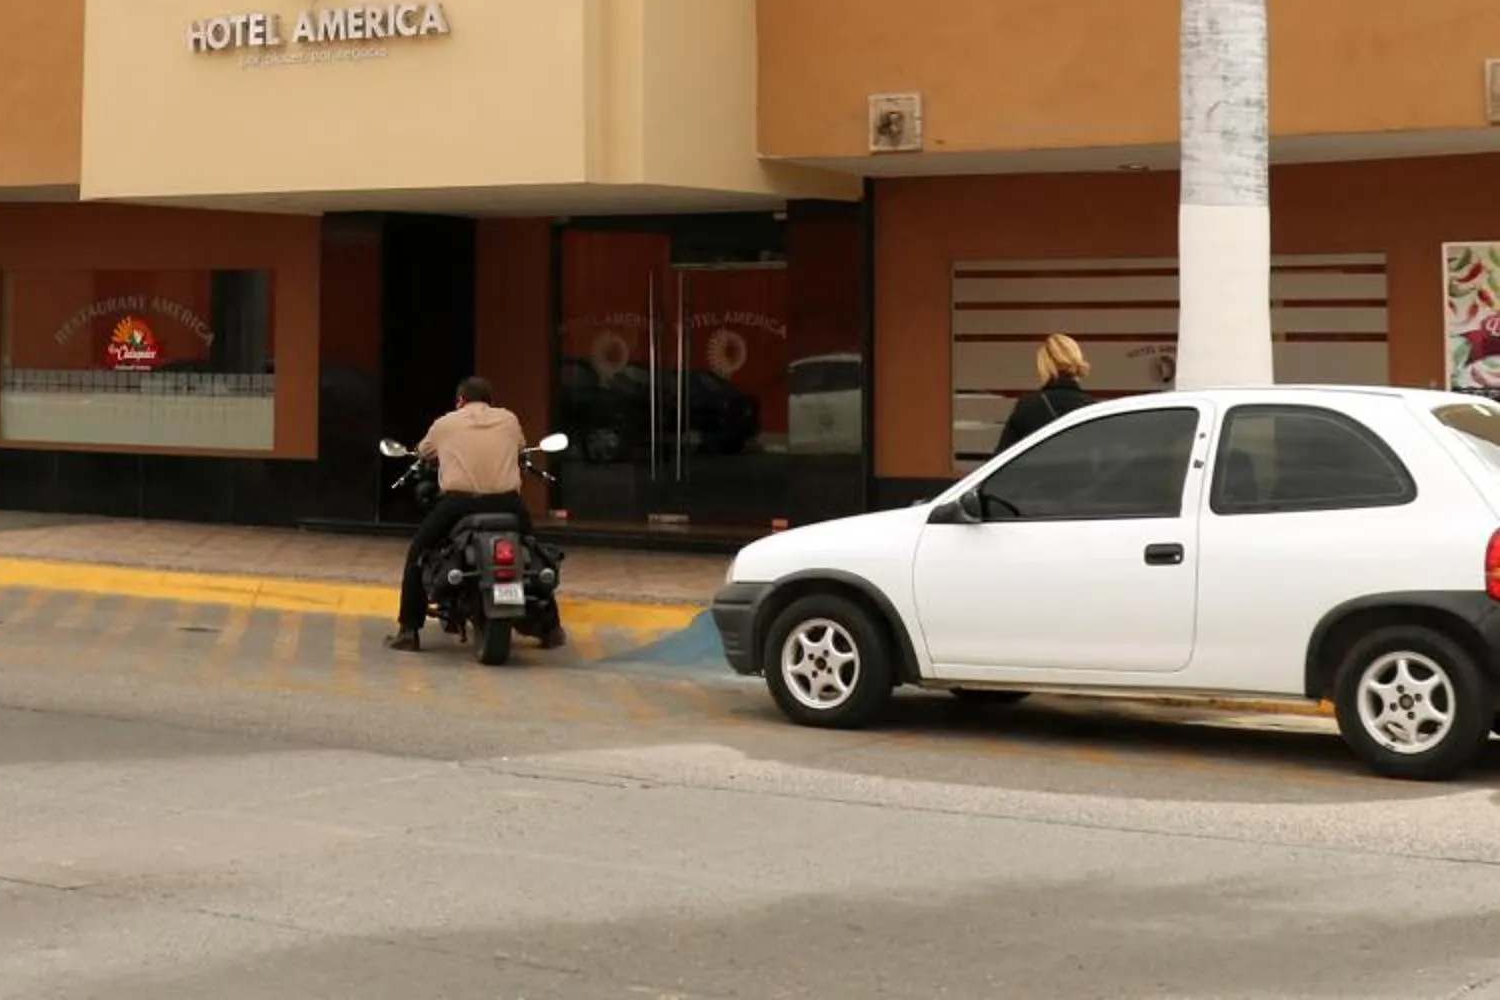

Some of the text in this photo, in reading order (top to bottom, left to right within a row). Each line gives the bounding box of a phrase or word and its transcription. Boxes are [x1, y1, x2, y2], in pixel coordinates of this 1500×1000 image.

[186, 2, 450, 53] HOTEL AMERICA
[53, 296, 216, 347] RESTAURANT AMERICA
[723, 309, 787, 341] AMERICA
